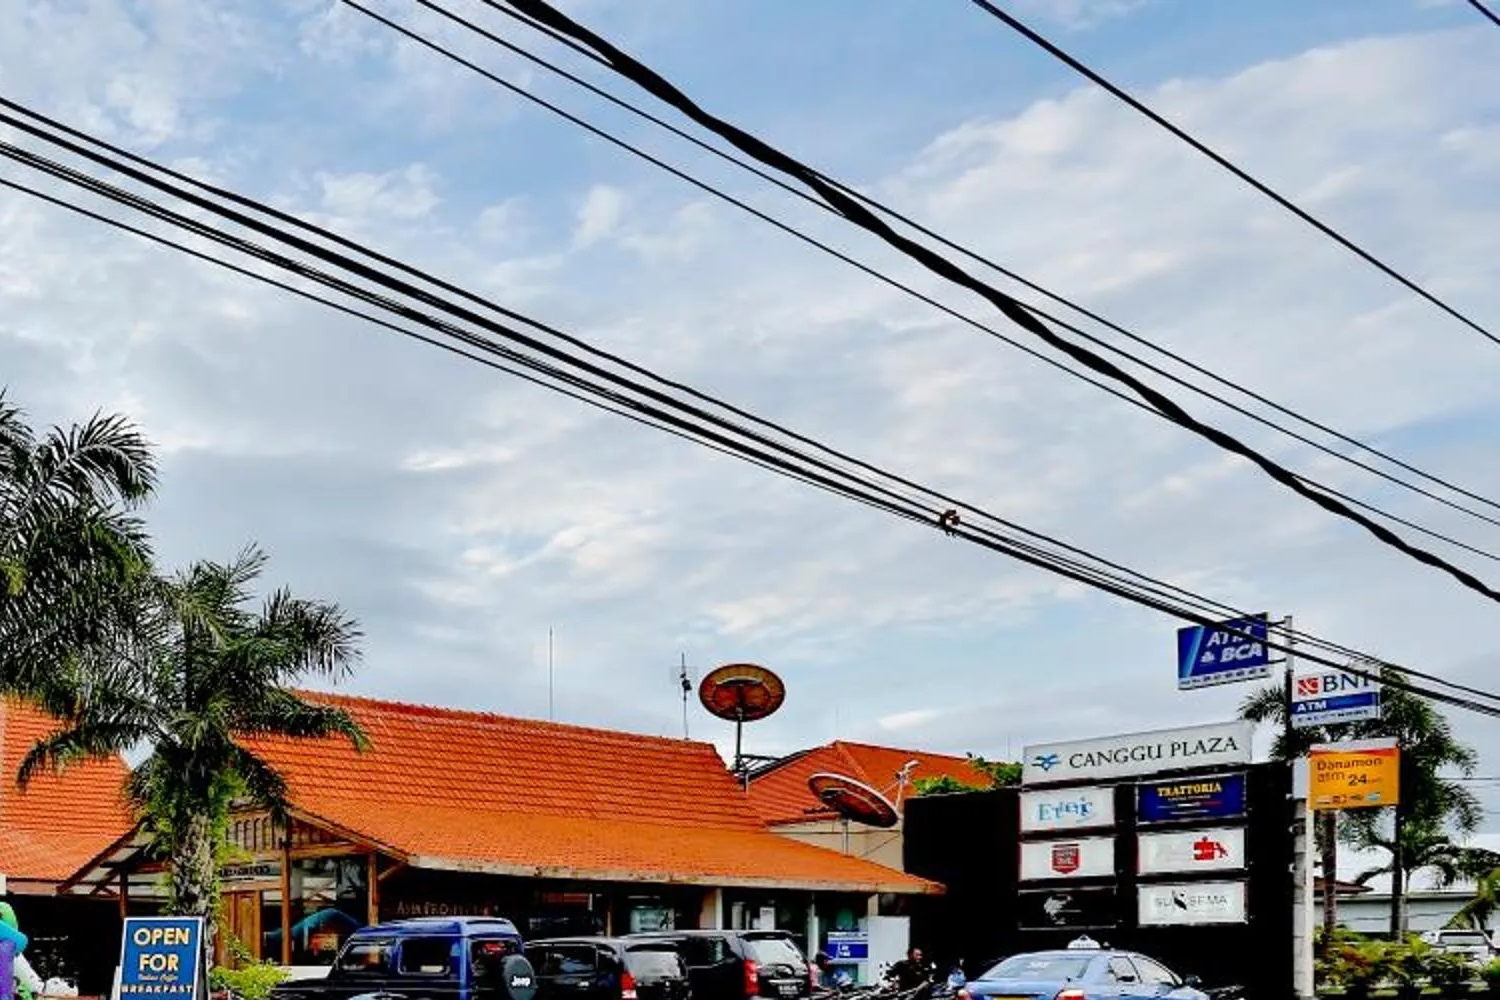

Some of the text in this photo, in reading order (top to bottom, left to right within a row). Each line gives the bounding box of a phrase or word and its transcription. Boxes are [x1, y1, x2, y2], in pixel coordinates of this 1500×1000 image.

[1219, 644, 1263, 663] BCA
[1323, 672, 1371, 692] BNI
[1296, 701, 1328, 713] ATM
[1068, 736, 1239, 769] CANGGU PLAZA
[1316, 757, 1383, 771] Danamon
[1348, 773, 1368, 786] 24
[1156, 781, 1223, 797] TRATTORIA
[133, 927, 190, 946] OPEN
[139, 953, 180, 972] FOR
[121, 984, 193, 993] BREAKFAST
[511, 975, 531, 988] Jeep
